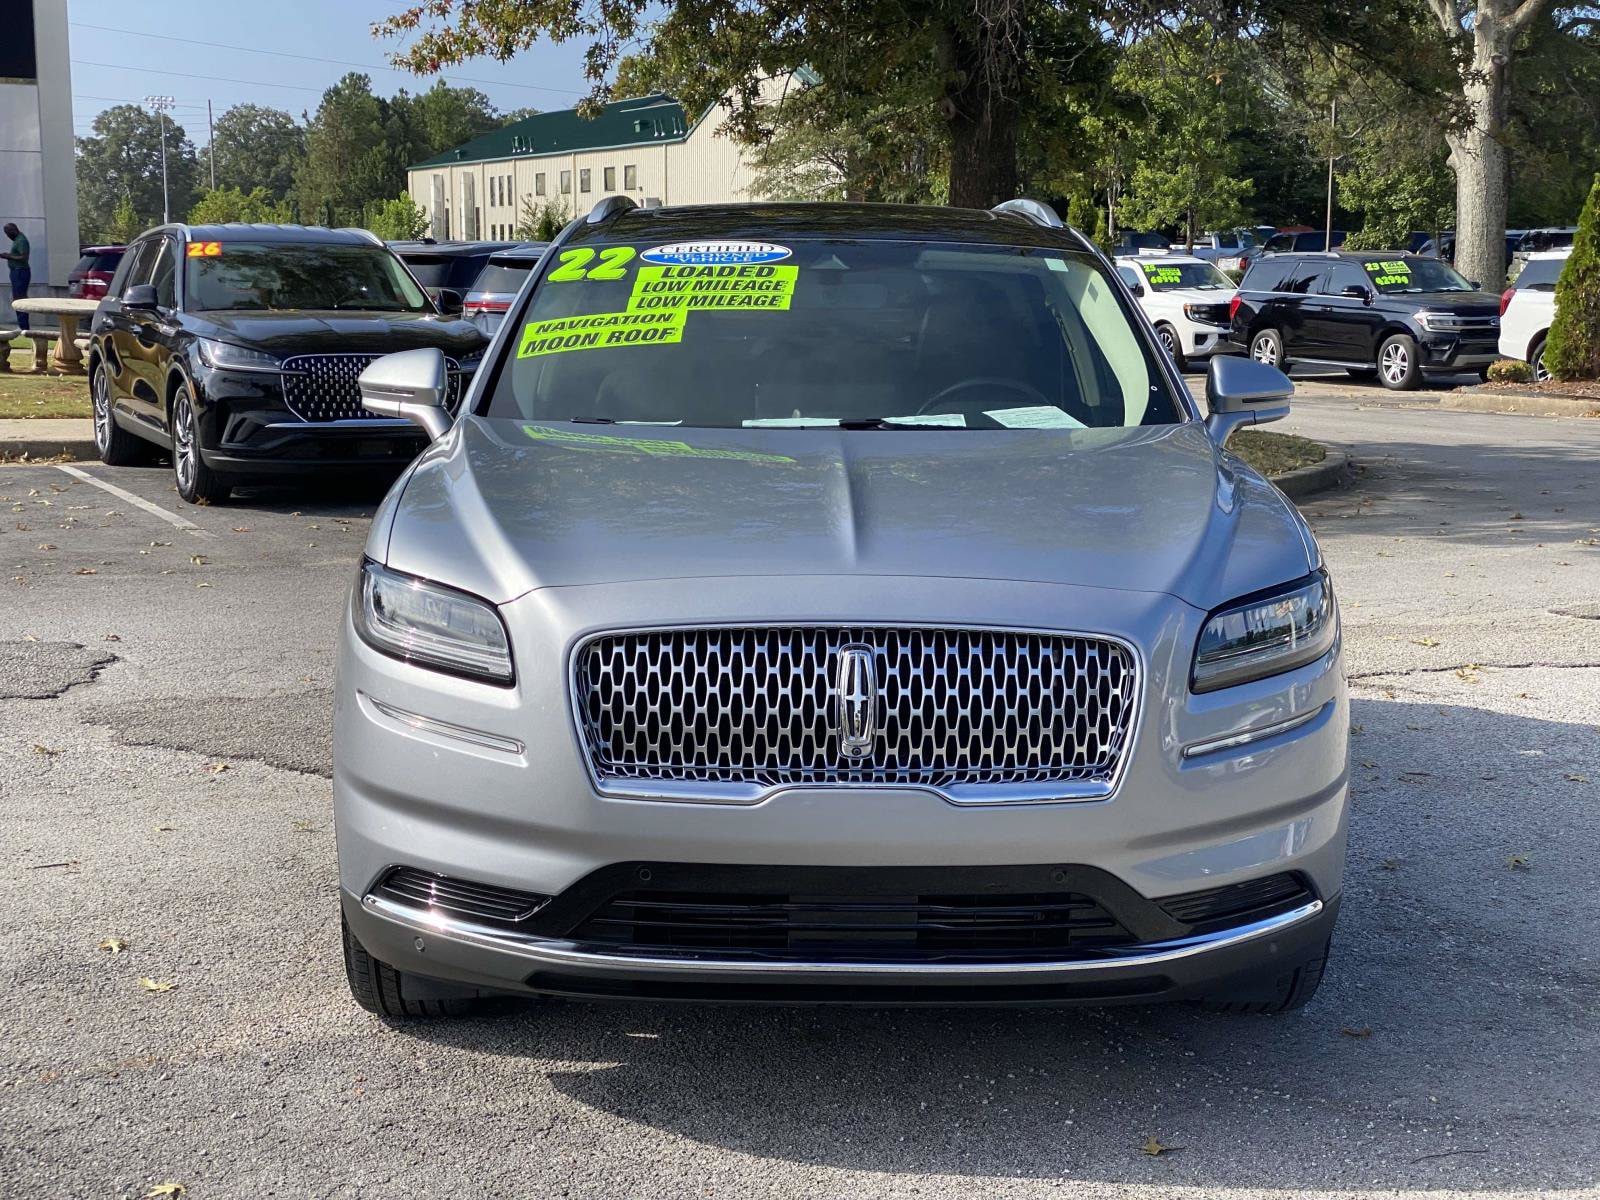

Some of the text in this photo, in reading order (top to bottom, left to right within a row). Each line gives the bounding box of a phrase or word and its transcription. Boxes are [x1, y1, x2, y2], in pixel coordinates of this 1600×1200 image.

[188, 242, 220, 256] 26
[659, 244, 775, 254] CERTIFIED
[547, 246, 636, 281] 22
[661, 265, 777, 279] LOADED
[641, 279, 788, 294] LOW MILEAGE
[635, 295, 784, 309] LOW MILEAGE
[535, 312, 676, 335] NAVIGATION
[522, 327, 678, 355] MOON ROOF
